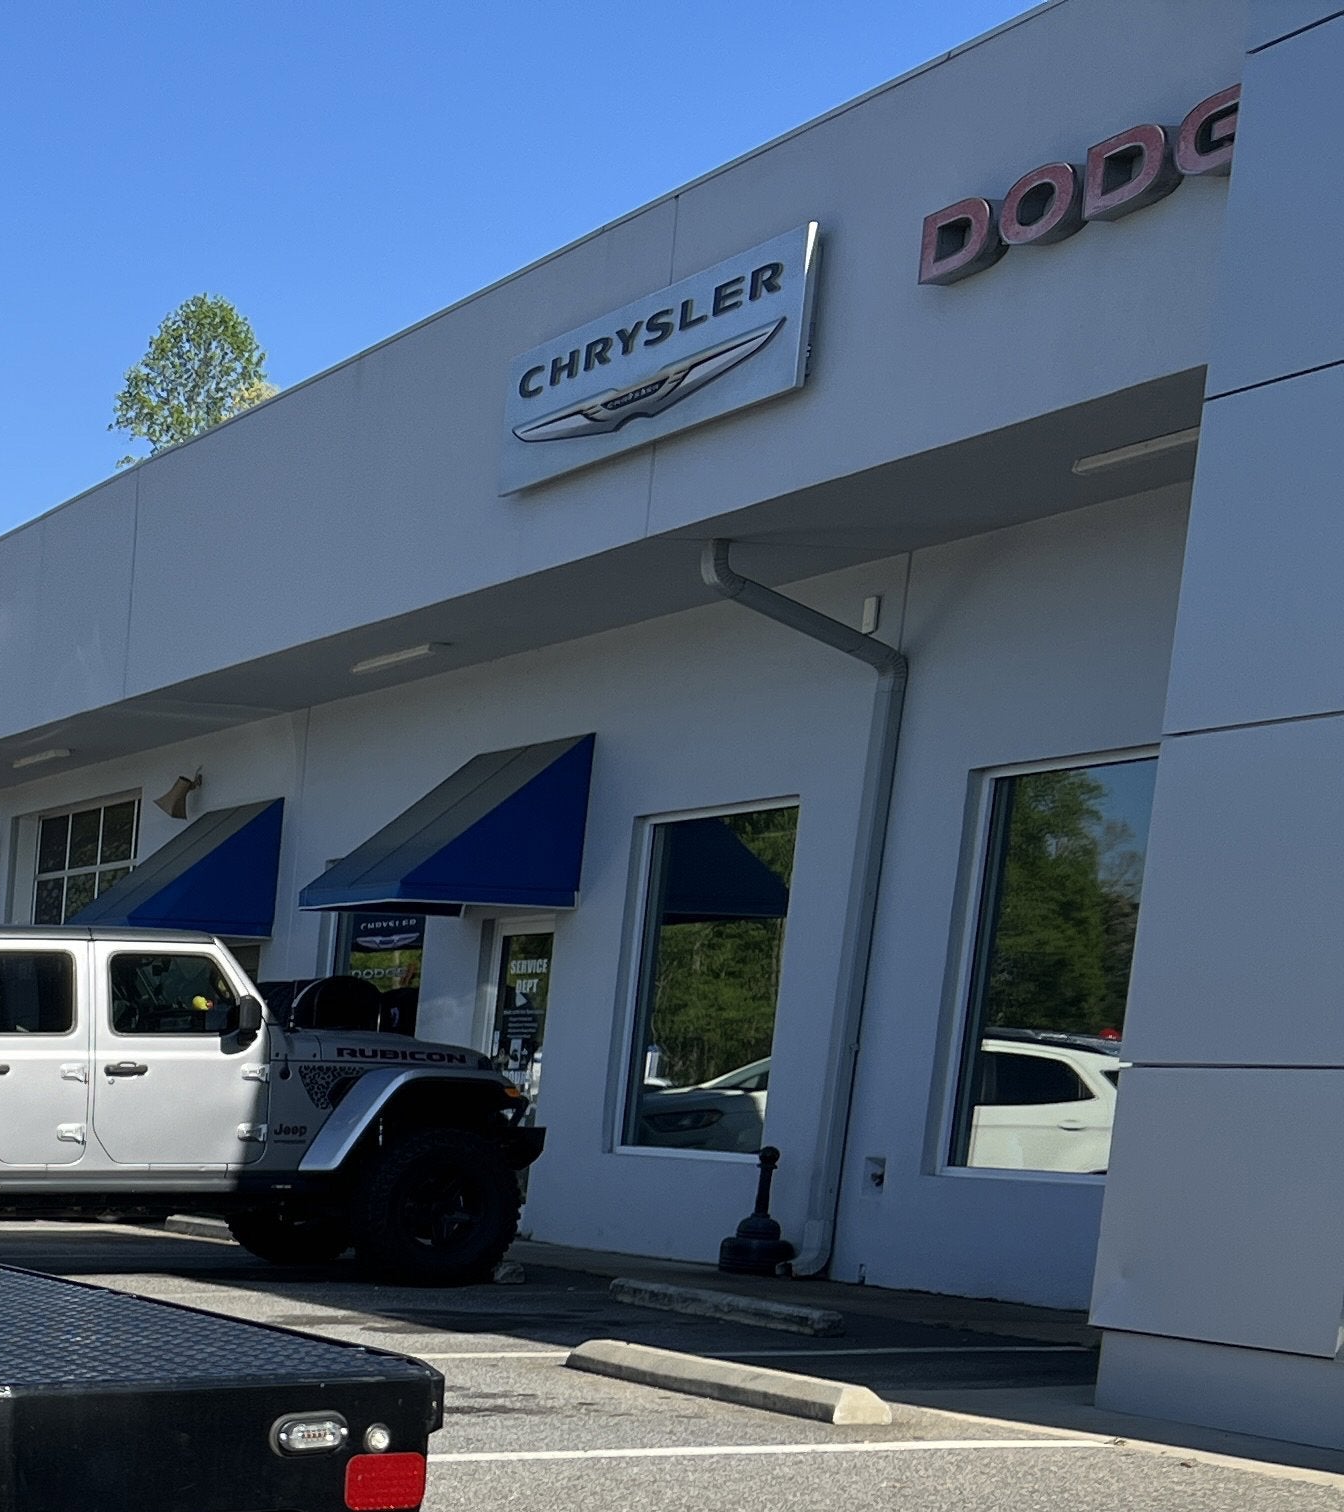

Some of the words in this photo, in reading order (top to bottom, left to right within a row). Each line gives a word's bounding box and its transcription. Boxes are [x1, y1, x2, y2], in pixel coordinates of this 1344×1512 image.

[519, 262, 784, 398] CHRYSLER
[511, 958, 548, 974] SERVICE
[515, 978, 539, 993] DEPT
[336, 1047, 467, 1064] RUBICON
[273, 1124, 308, 1137] Jeep
